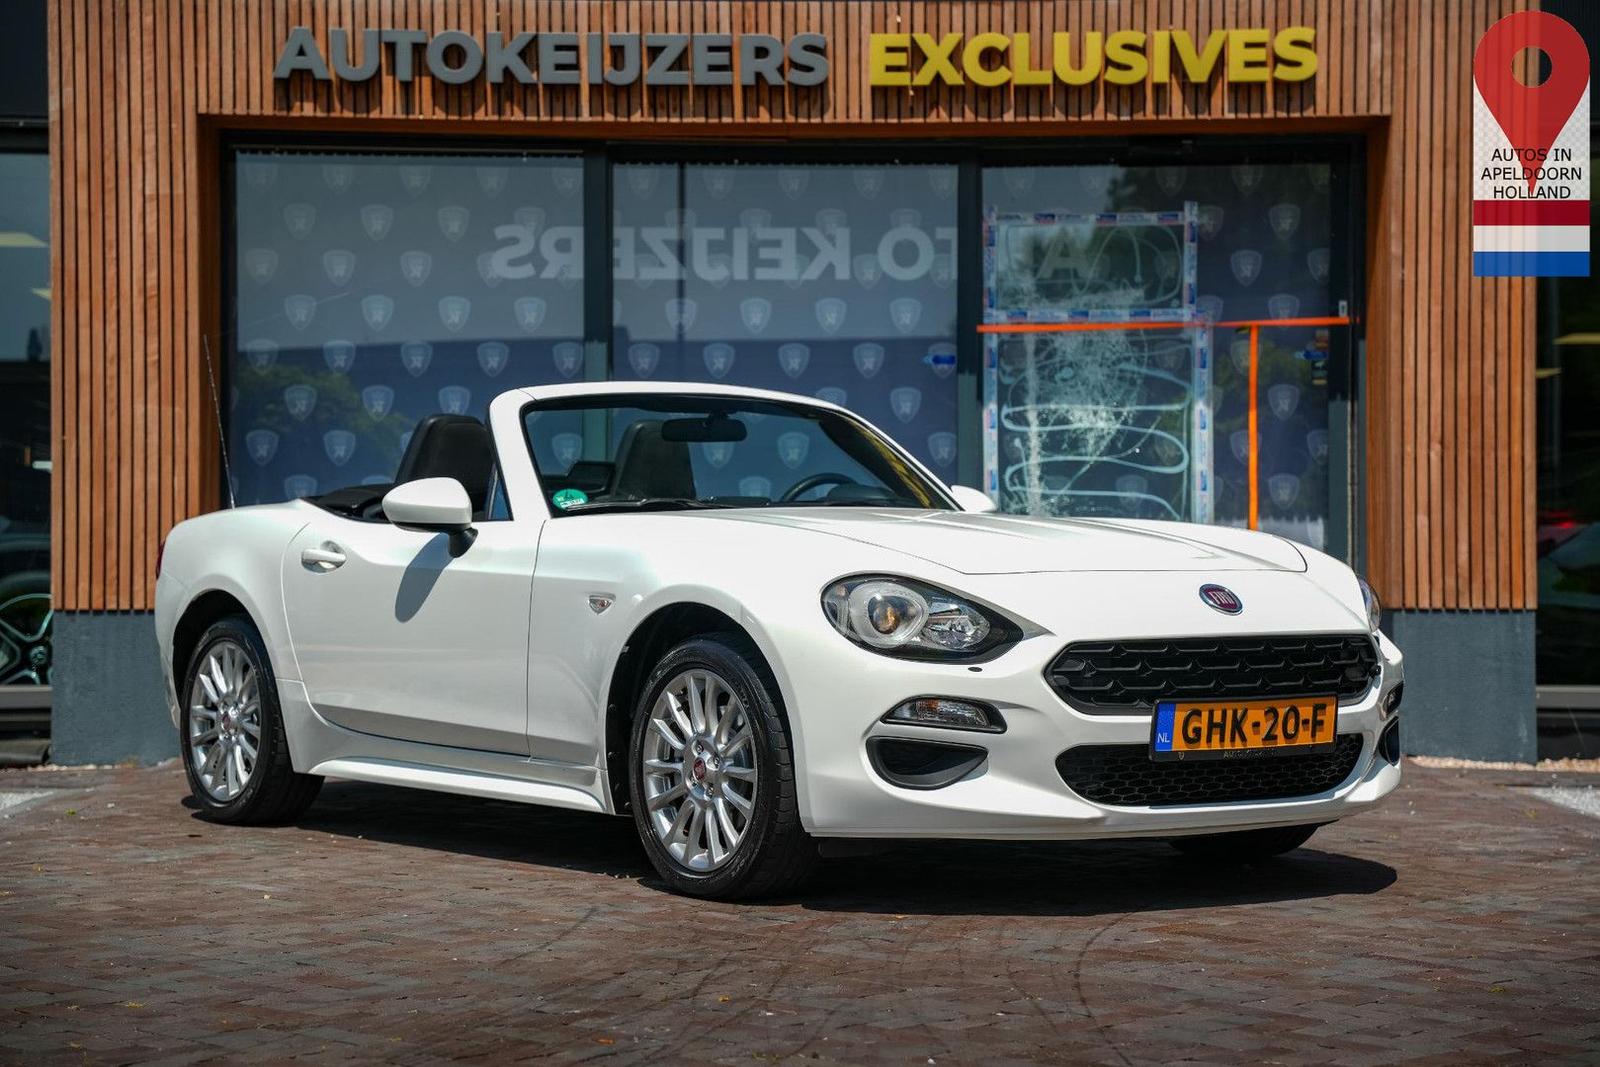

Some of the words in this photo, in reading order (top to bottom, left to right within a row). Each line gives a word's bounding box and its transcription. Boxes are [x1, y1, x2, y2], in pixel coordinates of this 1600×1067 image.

[273, 26, 829, 87] AUTOKEIJZERS
[869, 27, 1318, 87] EXCLUSIVES
[1157, 732, 1170, 743] NL
[1181, 703, 1327, 745] GHK-20-F
